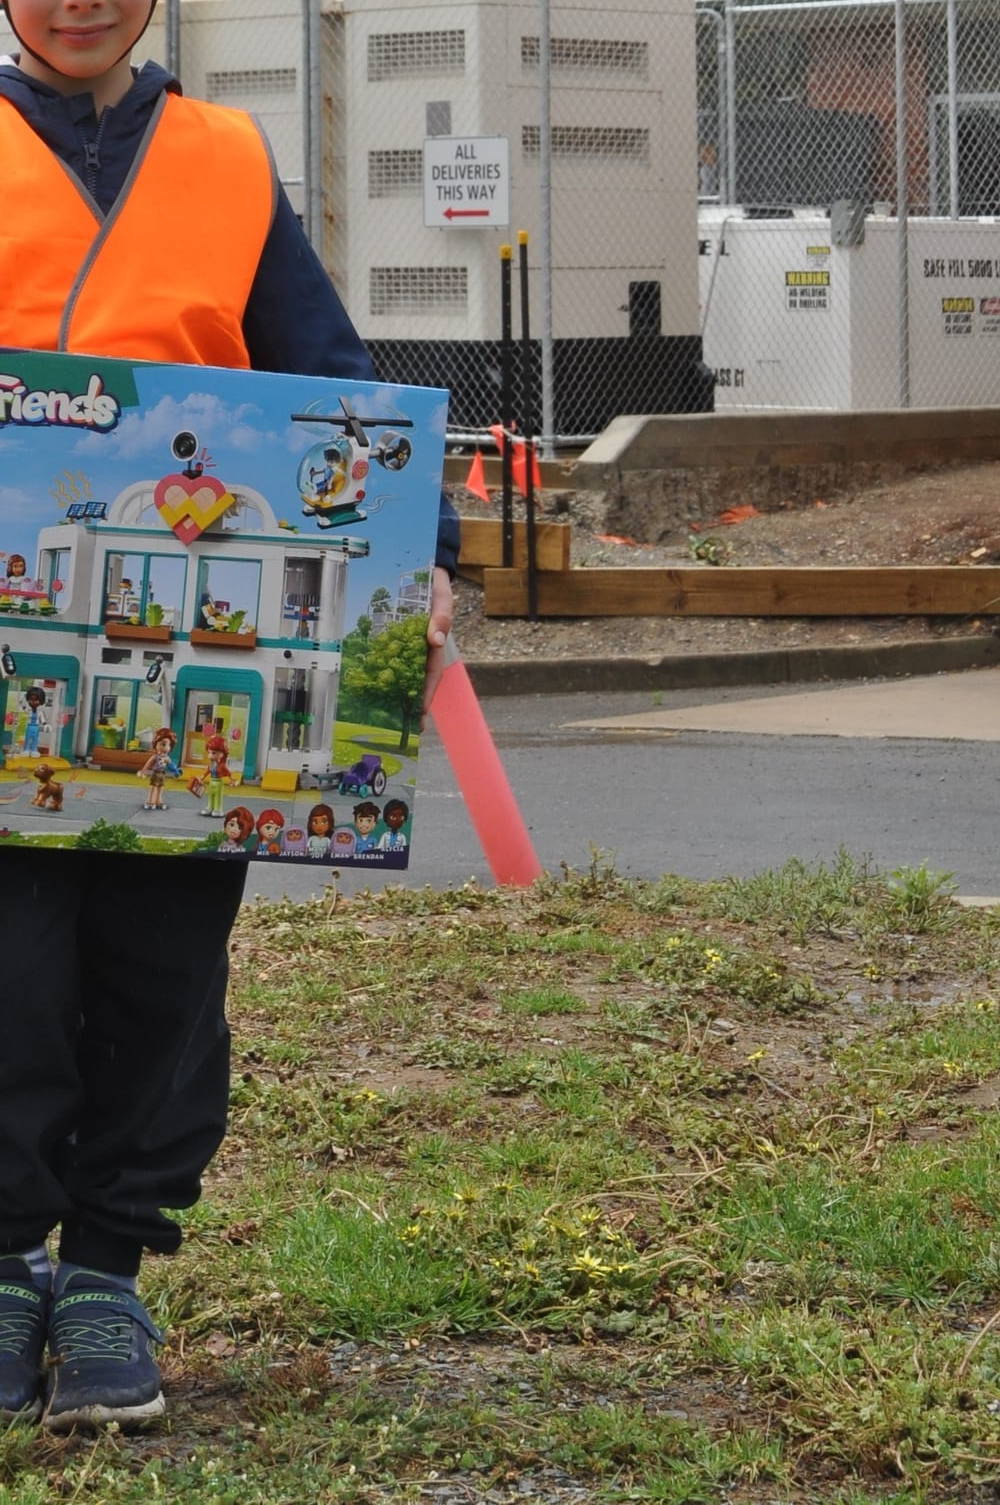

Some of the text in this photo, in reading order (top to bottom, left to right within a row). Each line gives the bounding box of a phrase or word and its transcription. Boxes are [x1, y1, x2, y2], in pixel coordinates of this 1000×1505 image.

[455, 144, 477, 160] ALL
[432, 164, 501, 181] DELIVERIES
[437, 184, 496, 200] THIS WAY
[923, 258, 945, 278] SAFE
